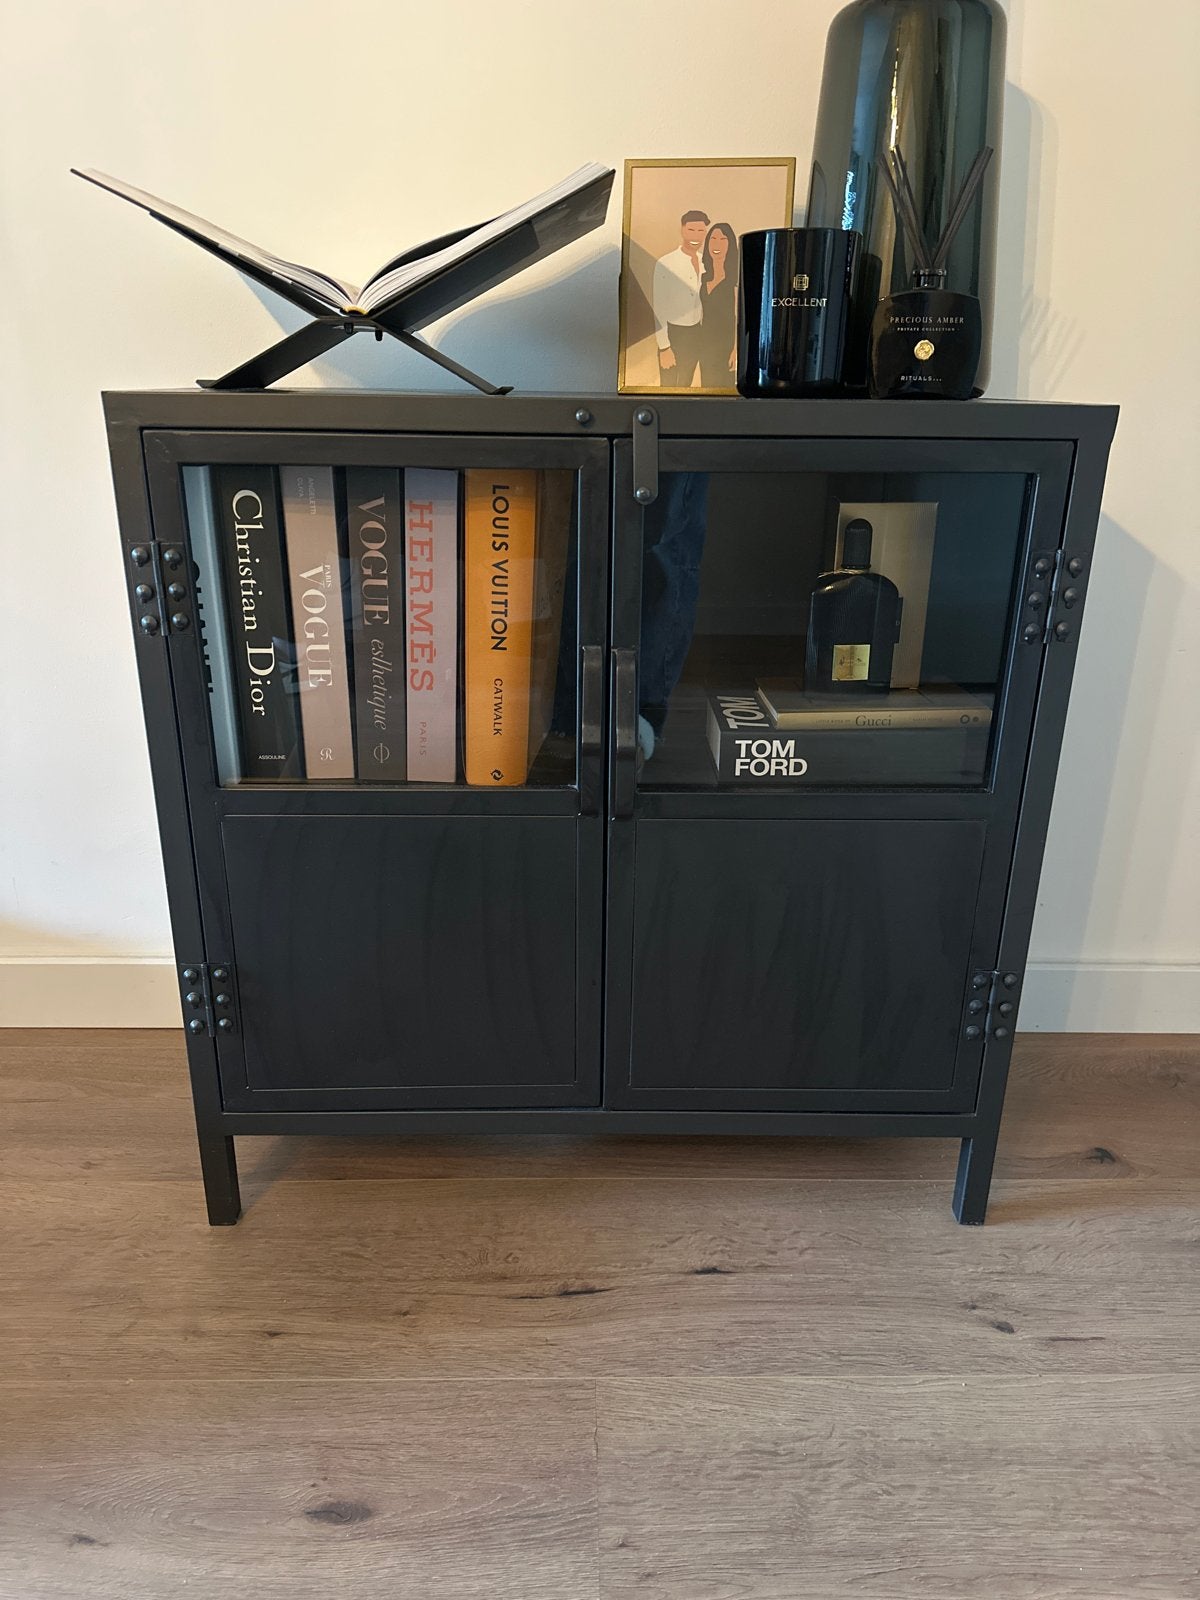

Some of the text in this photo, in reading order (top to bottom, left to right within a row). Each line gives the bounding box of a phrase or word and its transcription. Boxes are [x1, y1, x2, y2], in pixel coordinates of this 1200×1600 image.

[771, 297, 828, 307] EXCELLENT
[889, 316, 965, 324] PRECIOUS AMBER
[357, 495, 391, 626] VOGUE
[324, 564, 333, 589] PARIS
[232, 489, 275, 716] Christian Dior
[491, 484, 510, 736] LOUIS VUITTON CATWALK
[299, 563, 333, 688] VOGUE
[716, 695, 770, 729] TOM
[855, 715, 892, 727] Gucci
[419, 721, 428, 756] PARIS
[735, 739, 795, 758] TOM
[735, 758, 808, 776] FORD
